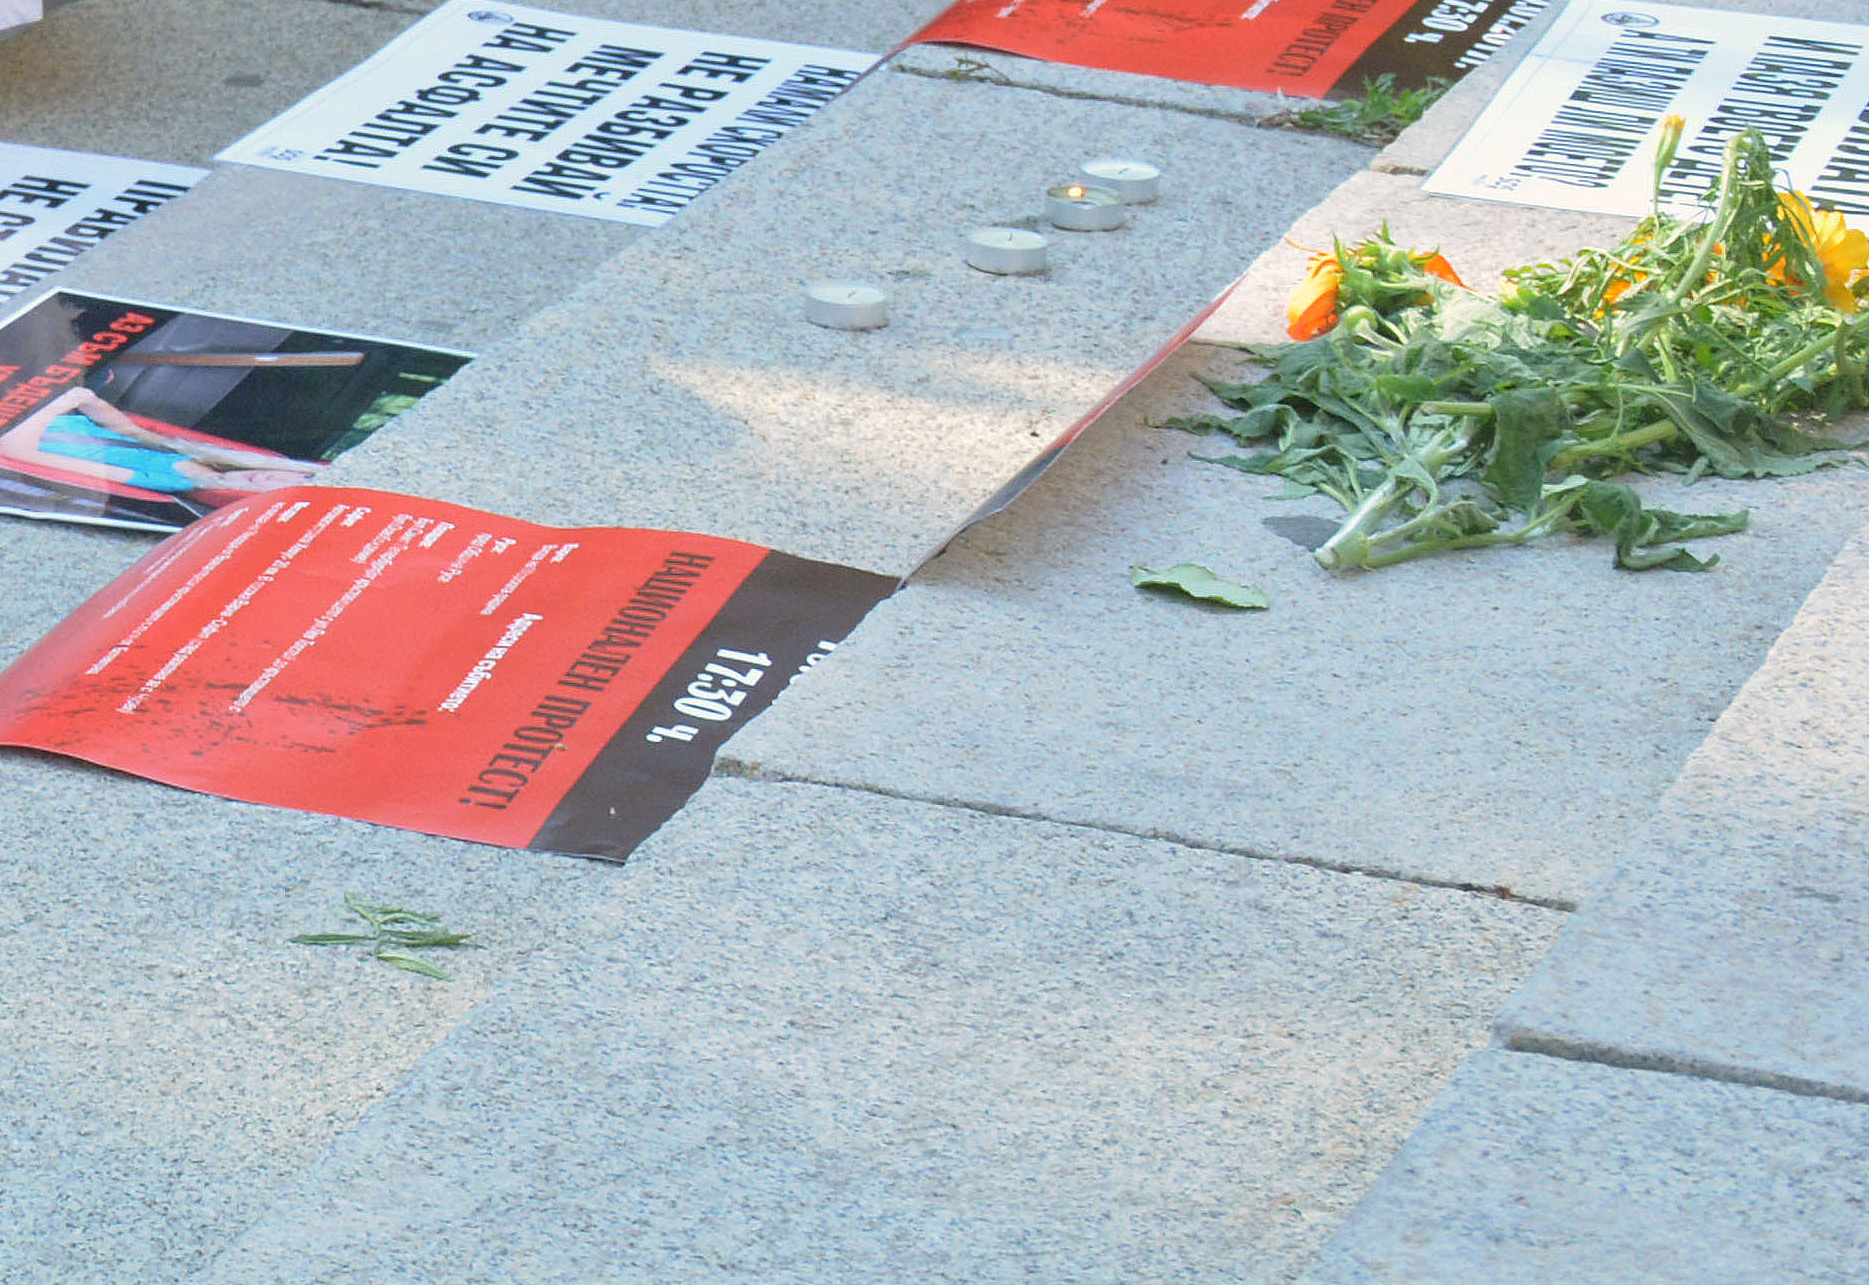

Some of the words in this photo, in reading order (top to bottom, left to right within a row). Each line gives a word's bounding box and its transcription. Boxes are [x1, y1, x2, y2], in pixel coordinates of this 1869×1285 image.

[483, 22, 576, 58] НА
[676, 52, 771, 83] НЕ
[1605, 42, 1709, 64] ТИ
[474, 44, 665, 142] МЕЧТИТЕ
[735, 65, 861, 127] НАМАЛИ
[1569, 58, 1695, 112] ПАЗИШ
[1731, 52, 1852, 99] ПАЗЯ
[313, 54, 509, 168] АСФАЛТА!
[1551, 105, 1658, 135] ЛИ
[421, 143, 511, 180] СИ
[510, 83, 729, 200] РАЗБИВАЙ
[1509, 129, 1641, 188] МОЕТО?
[564, 551, 714, 693] НАЦИОНАЛЕН
[672, 648, 772, 722] 17:30
[458, 694, 591, 811] ПРОТЕСТ!
[645, 724, 699, 743] ч.
